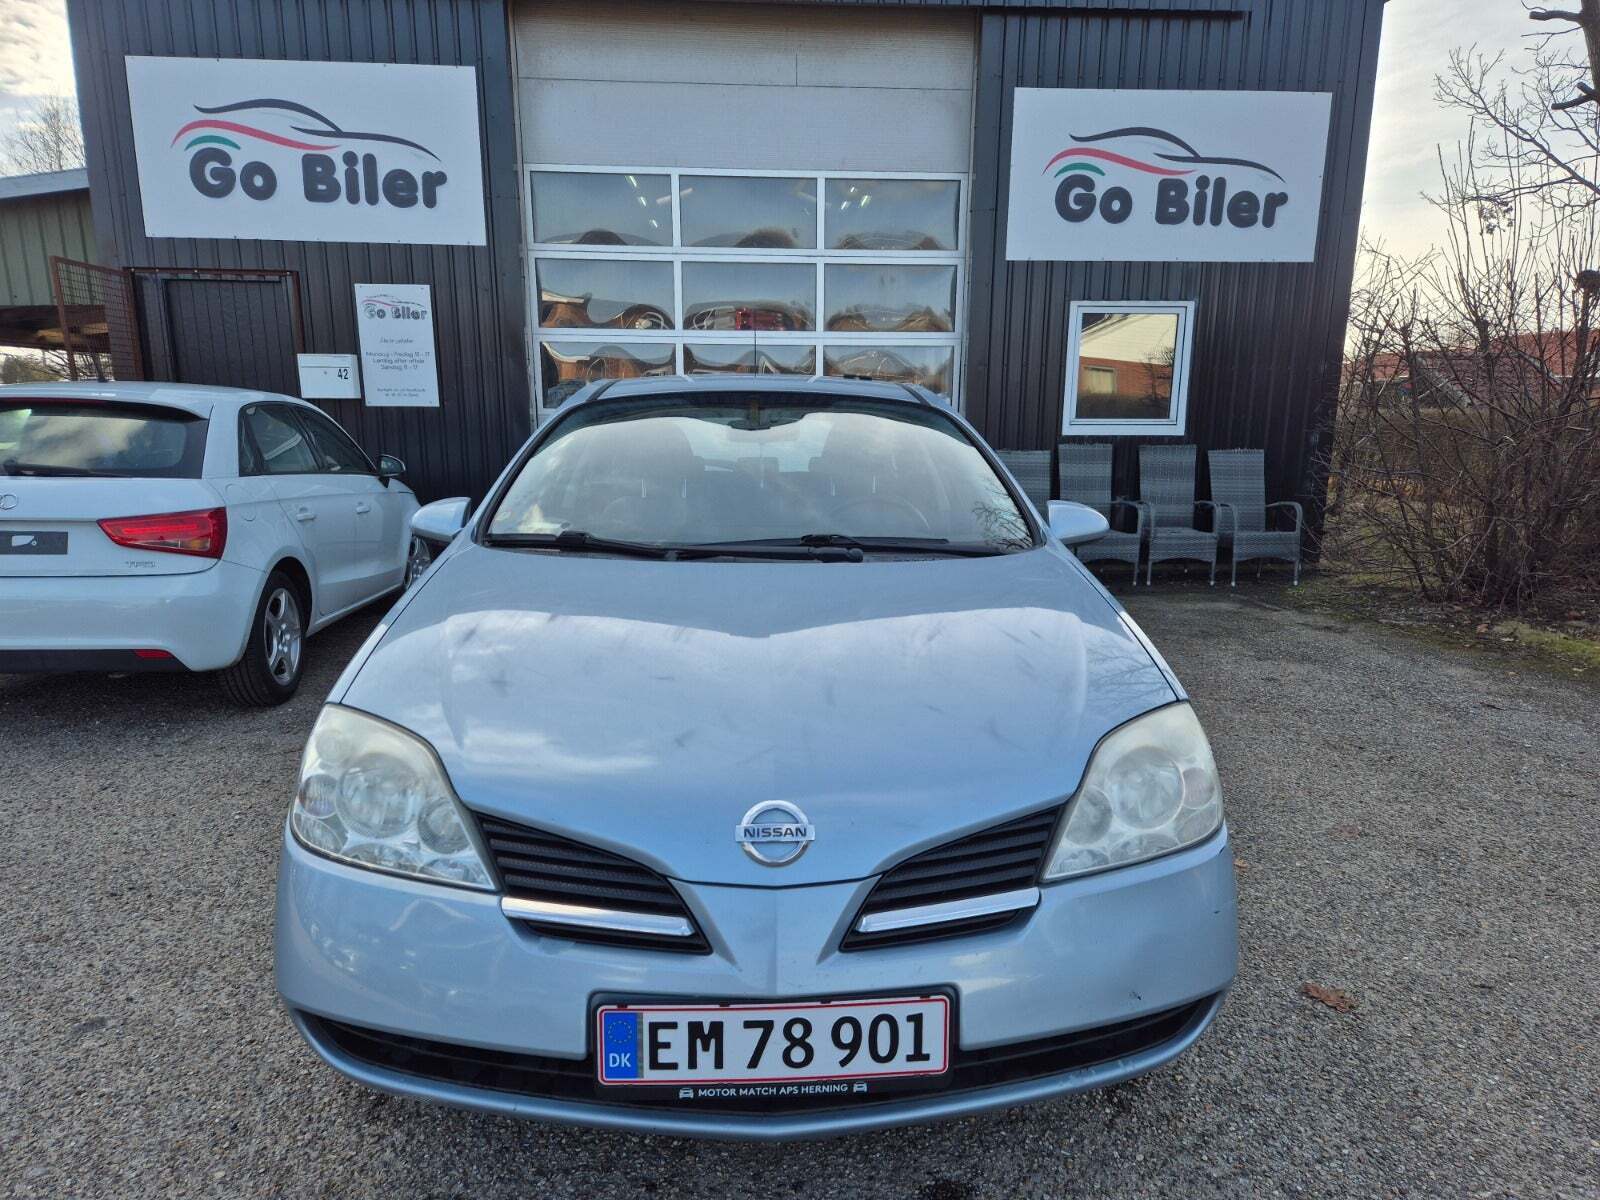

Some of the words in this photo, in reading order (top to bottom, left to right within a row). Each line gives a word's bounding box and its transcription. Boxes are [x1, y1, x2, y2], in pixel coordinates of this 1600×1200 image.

[189, 147, 278, 201] Go
[301, 150, 448, 209] Biler
[1054, 174, 1133, 225] Go
[1154, 174, 1289, 229] Biler
[363, 304, 387, 320] Go
[391, 305, 428, 321] Biler
[337, 368, 349, 380] 42
[743, 827, 807, 838] NISSAN
[649, 1021, 725, 1071] EM
[742, 1017, 815, 1070] 78
[830, 1012, 931, 1068] 901
[609, 1053, 632, 1069] DK
[698, 1088, 737, 1098] MOTOR
[739, 1086, 777, 1097] MATCH
[779, 1085, 799, 1095] APS
[801, 1083, 848, 1095] HERNING
